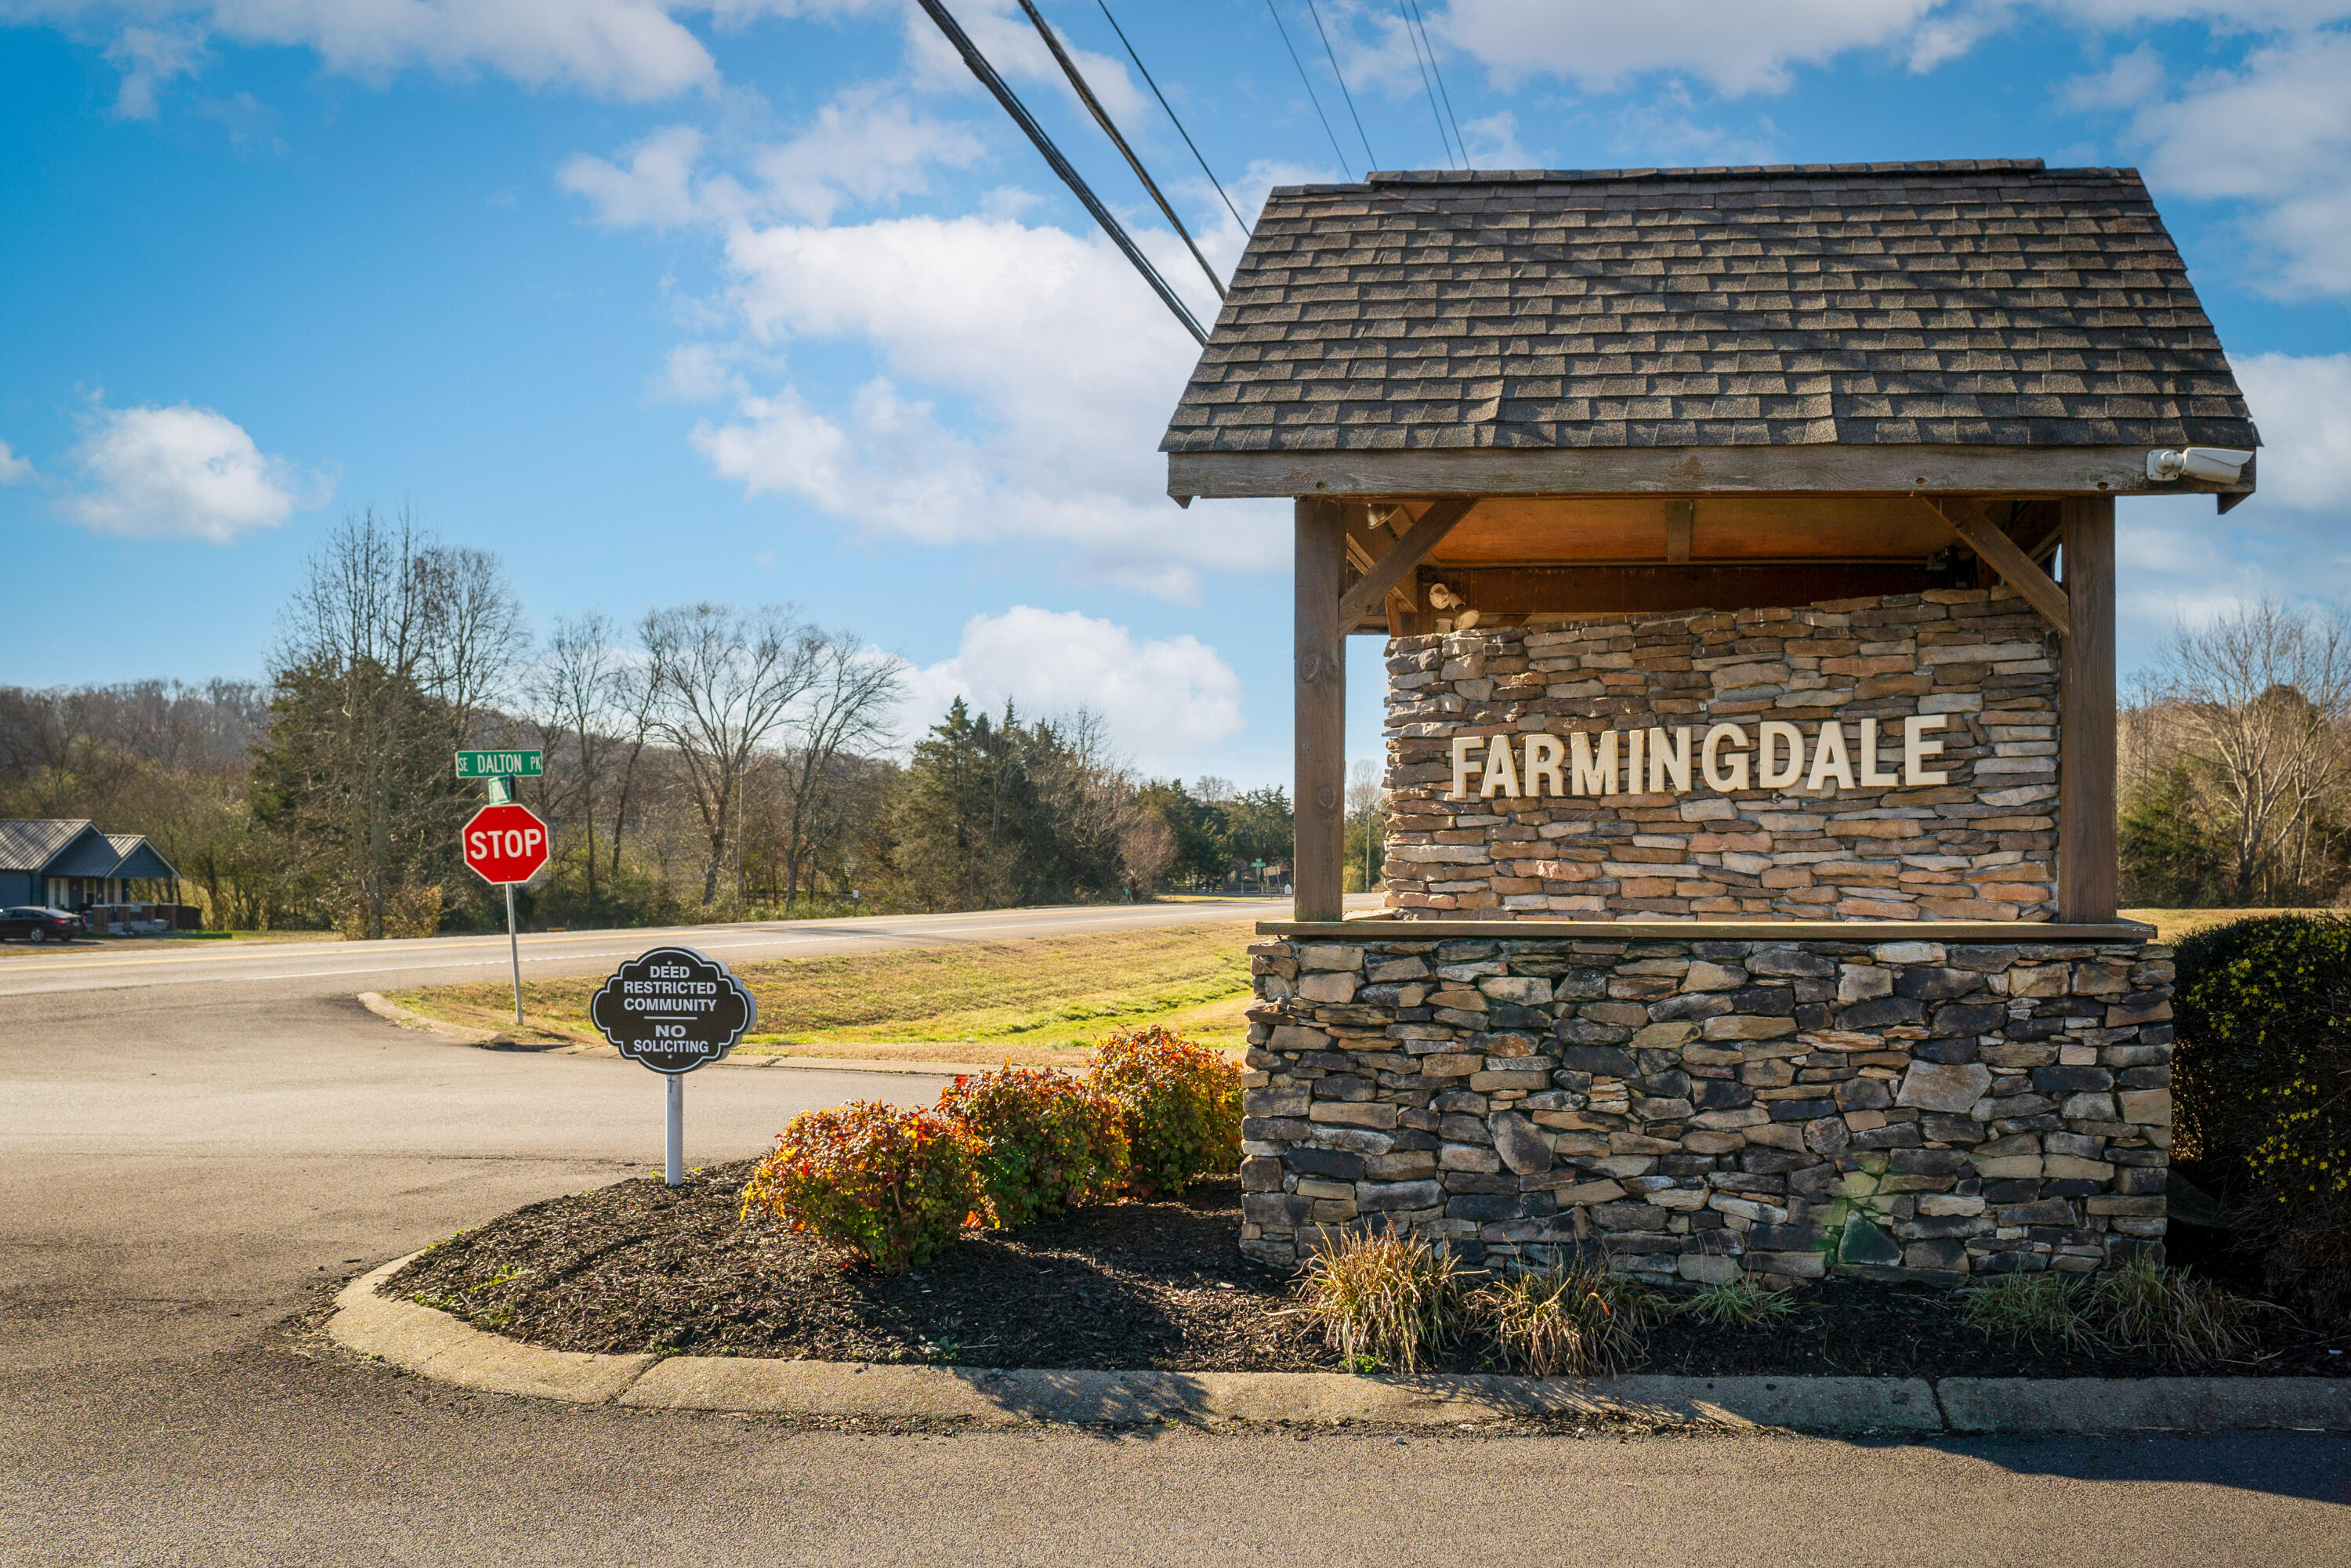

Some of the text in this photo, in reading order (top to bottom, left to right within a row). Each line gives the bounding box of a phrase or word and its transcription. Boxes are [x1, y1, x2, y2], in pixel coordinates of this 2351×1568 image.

[1452, 714, 1948, 799] FARMINGDALE
[458, 757, 469, 772] SE
[477, 755, 522, 773] DALTON
[470, 828, 542, 860] STOP
[650, 965, 690, 978] DEED
[624, 981, 717, 994] RESTRICTED
[624, 998, 717, 1011] COMMUNITY
[655, 1025, 686, 1037] NO
[633, 1039, 709, 1053] SOLICITING
